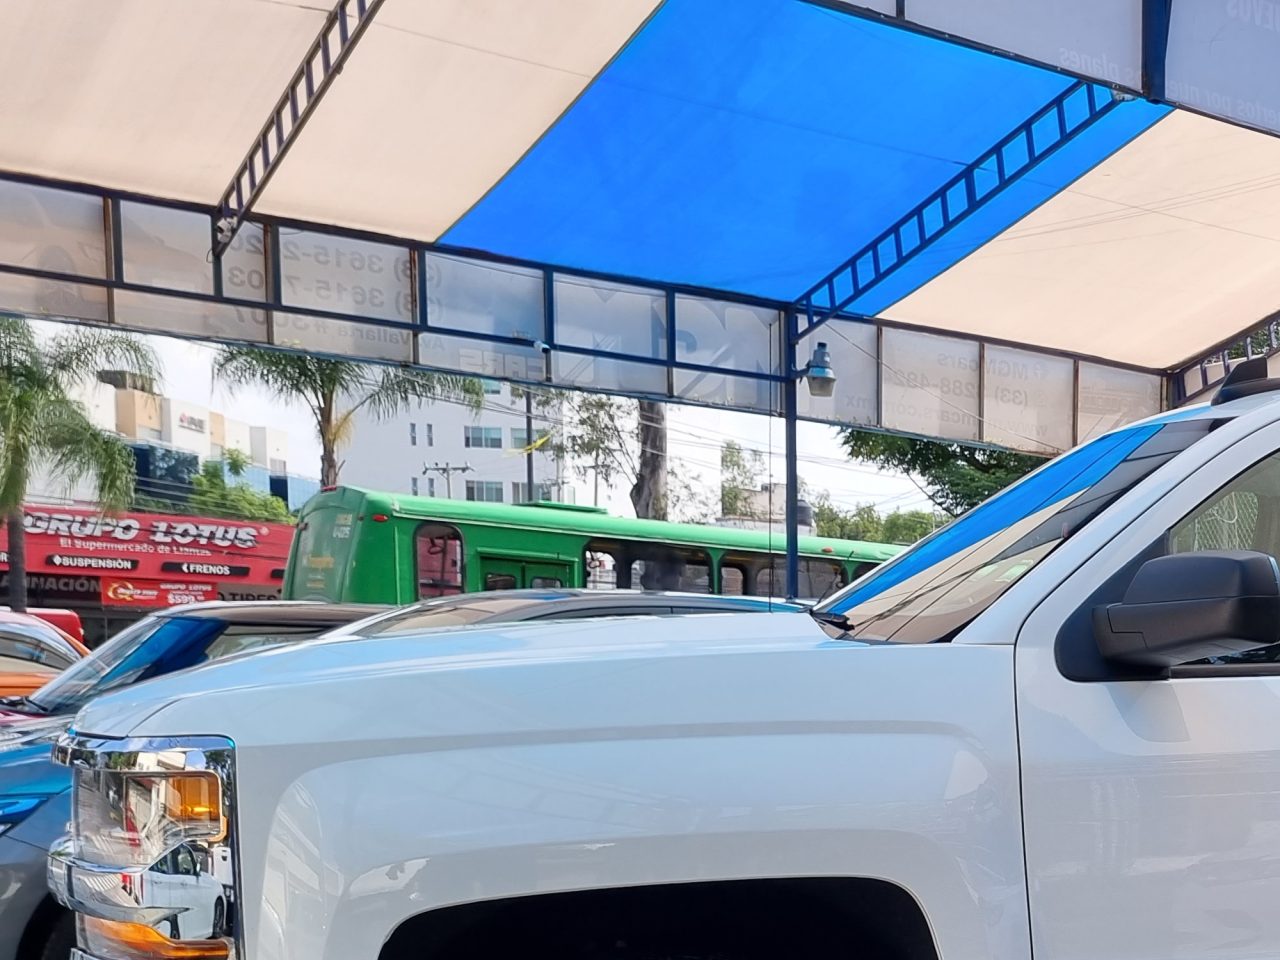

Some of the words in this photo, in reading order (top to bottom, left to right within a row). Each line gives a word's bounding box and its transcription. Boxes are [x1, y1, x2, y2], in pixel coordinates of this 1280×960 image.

[23, 511, 141, 543] GRUPO
[149, 521, 260, 549] LOTUS
[61, 555, 132, 570] SUSPENSIÓN
[188, 563, 231, 577] FRENOS
